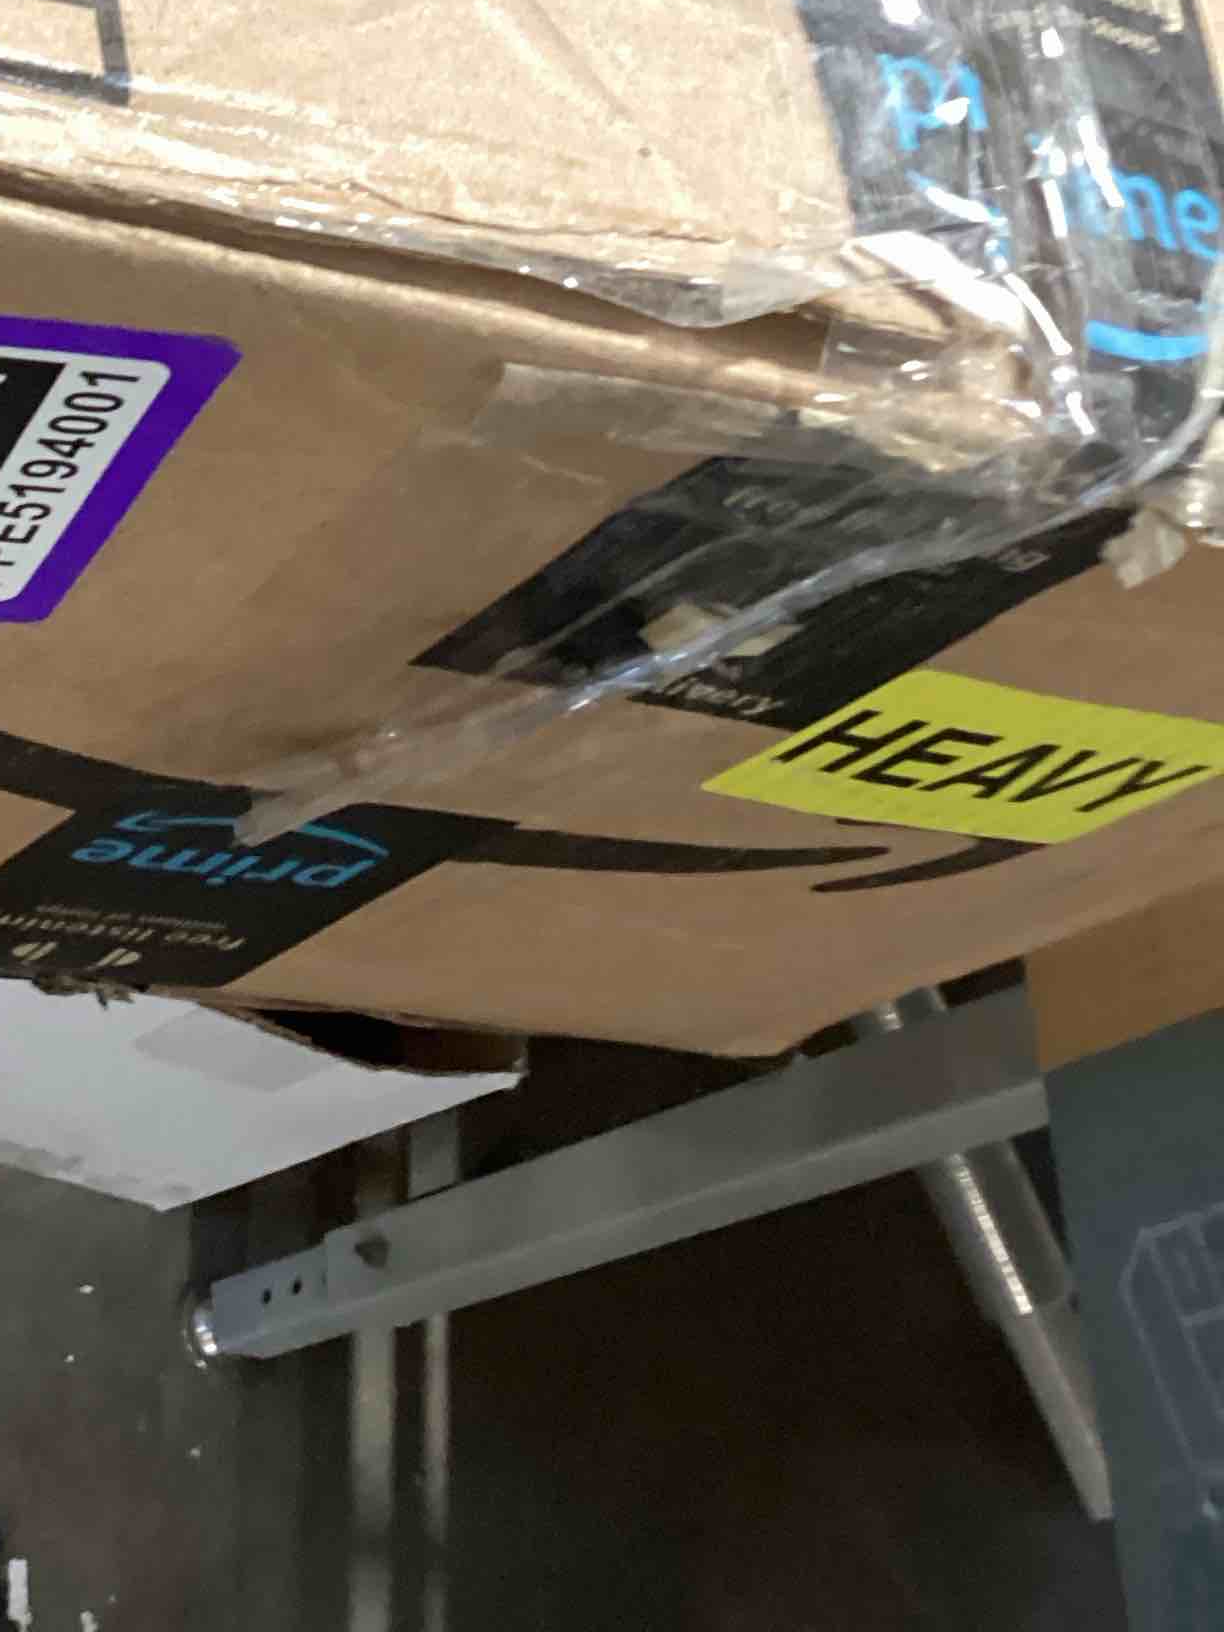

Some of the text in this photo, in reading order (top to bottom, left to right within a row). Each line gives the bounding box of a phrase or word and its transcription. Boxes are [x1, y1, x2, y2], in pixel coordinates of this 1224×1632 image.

[772, 708, 1214, 814] HEAVY
[72, 836, 378, 889] prime
[167, 928, 247, 951] free
